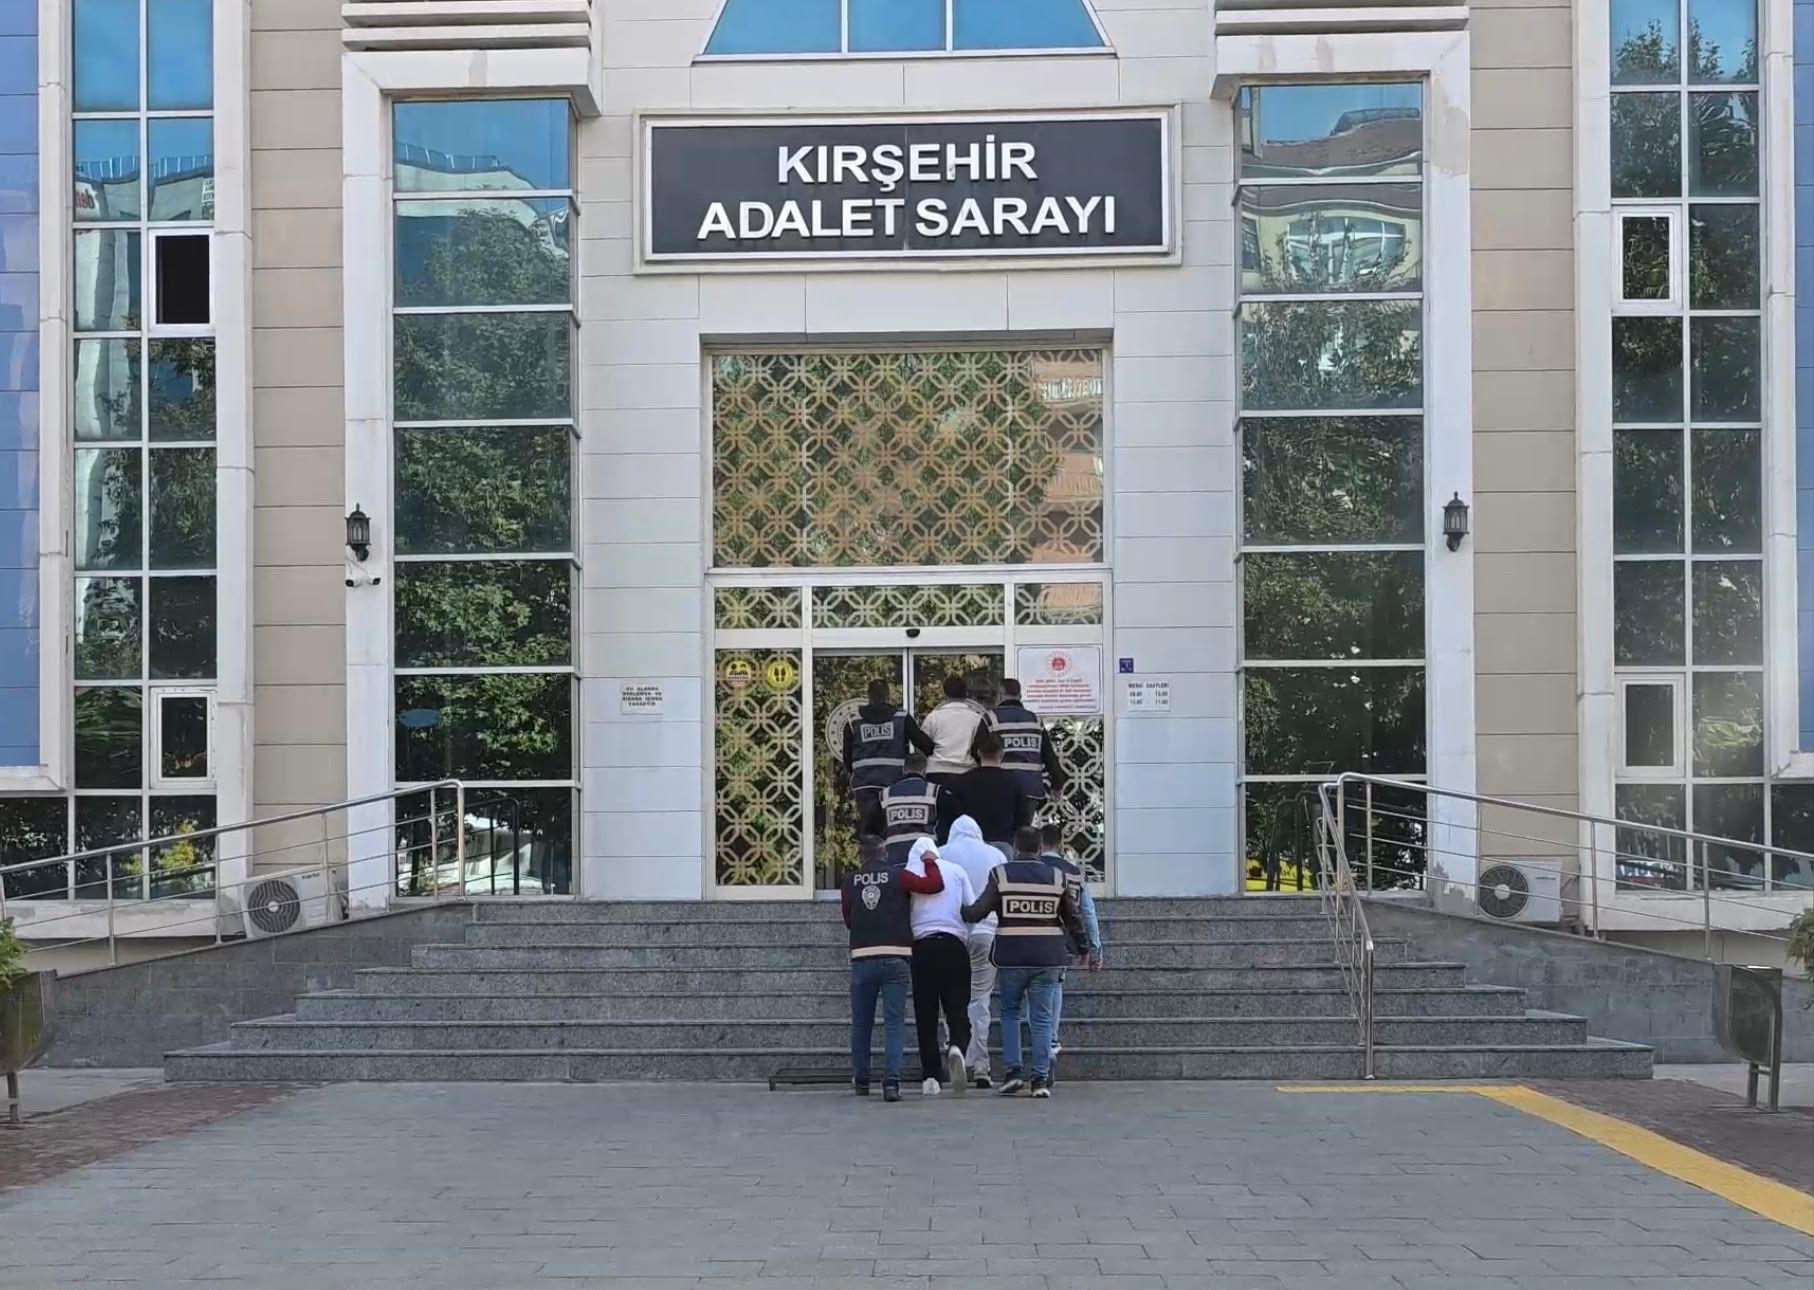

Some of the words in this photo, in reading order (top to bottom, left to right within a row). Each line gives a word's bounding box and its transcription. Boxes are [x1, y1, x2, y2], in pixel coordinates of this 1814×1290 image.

[777, 134, 1039, 193] KIRŞEHİR
[697, 198, 906, 241] ADALET
[915, 195, 1116, 237] SARAYI
